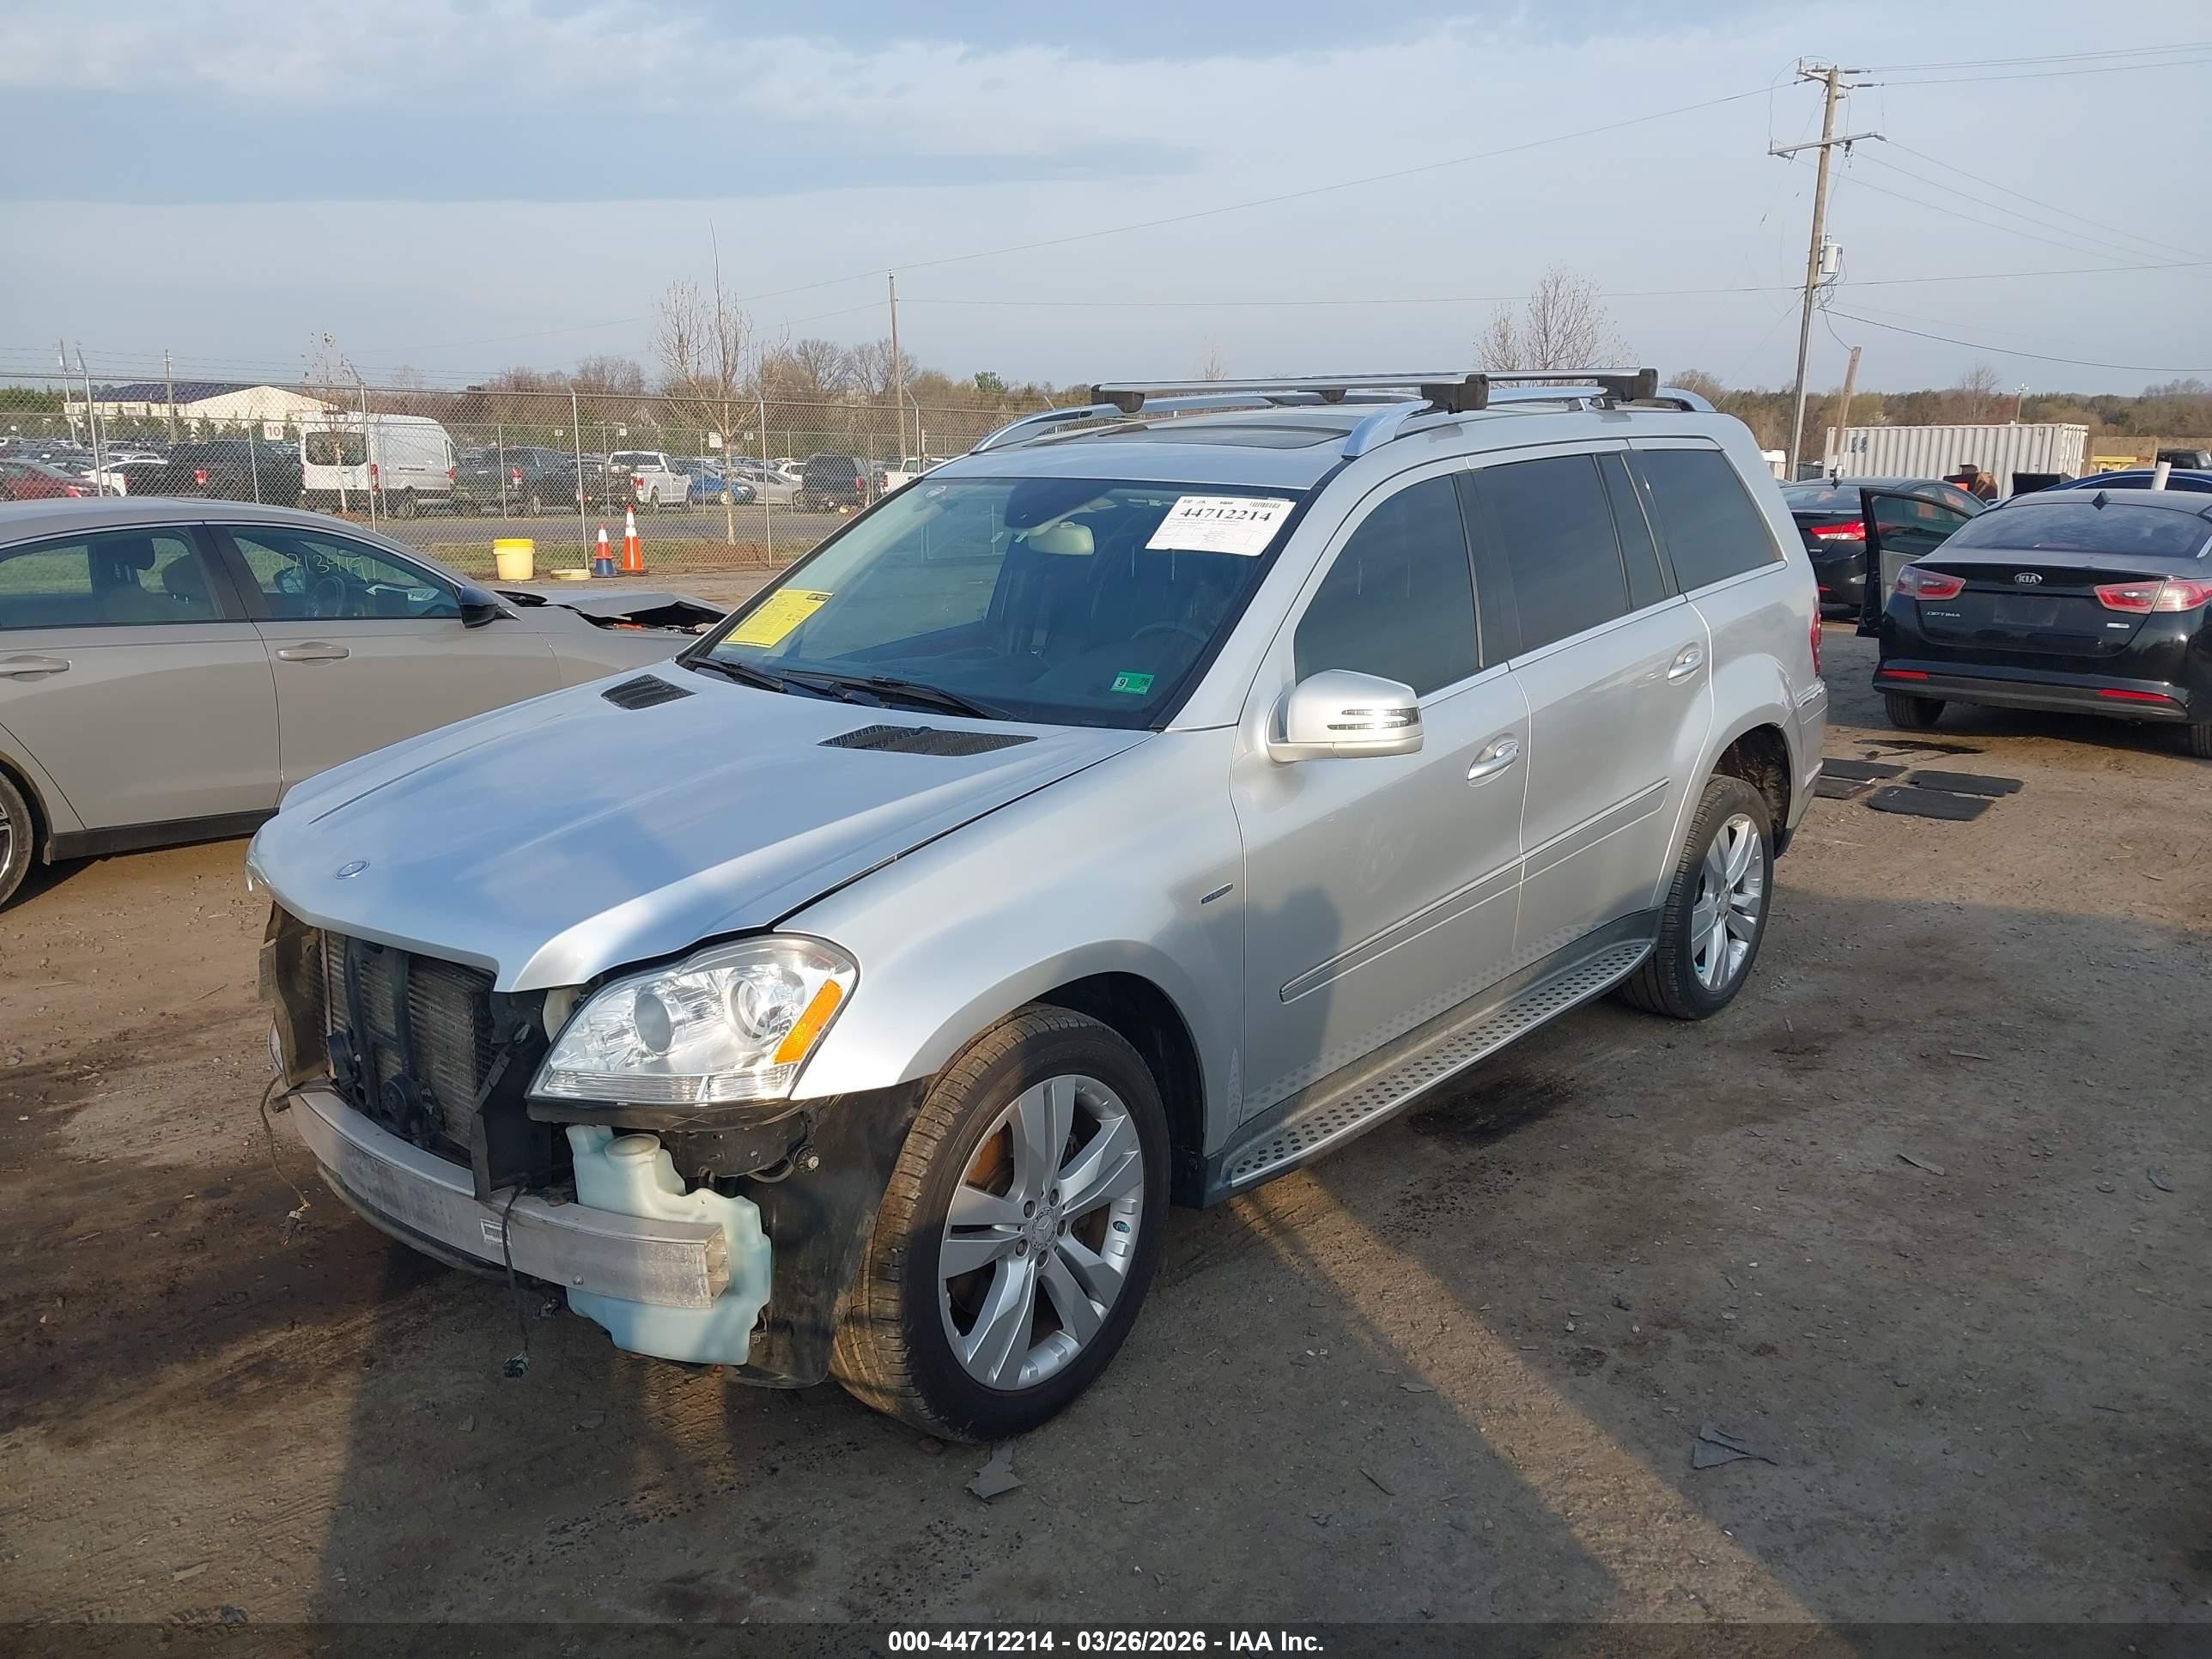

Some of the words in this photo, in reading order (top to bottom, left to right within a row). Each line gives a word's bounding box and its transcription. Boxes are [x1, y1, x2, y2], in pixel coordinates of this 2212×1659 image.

[266, 426, 281, 437] 10
[1179, 507, 1273, 522] 44712214
[2018, 574, 2038, 584] KIA
[1118, 678, 1127, 687] 9
